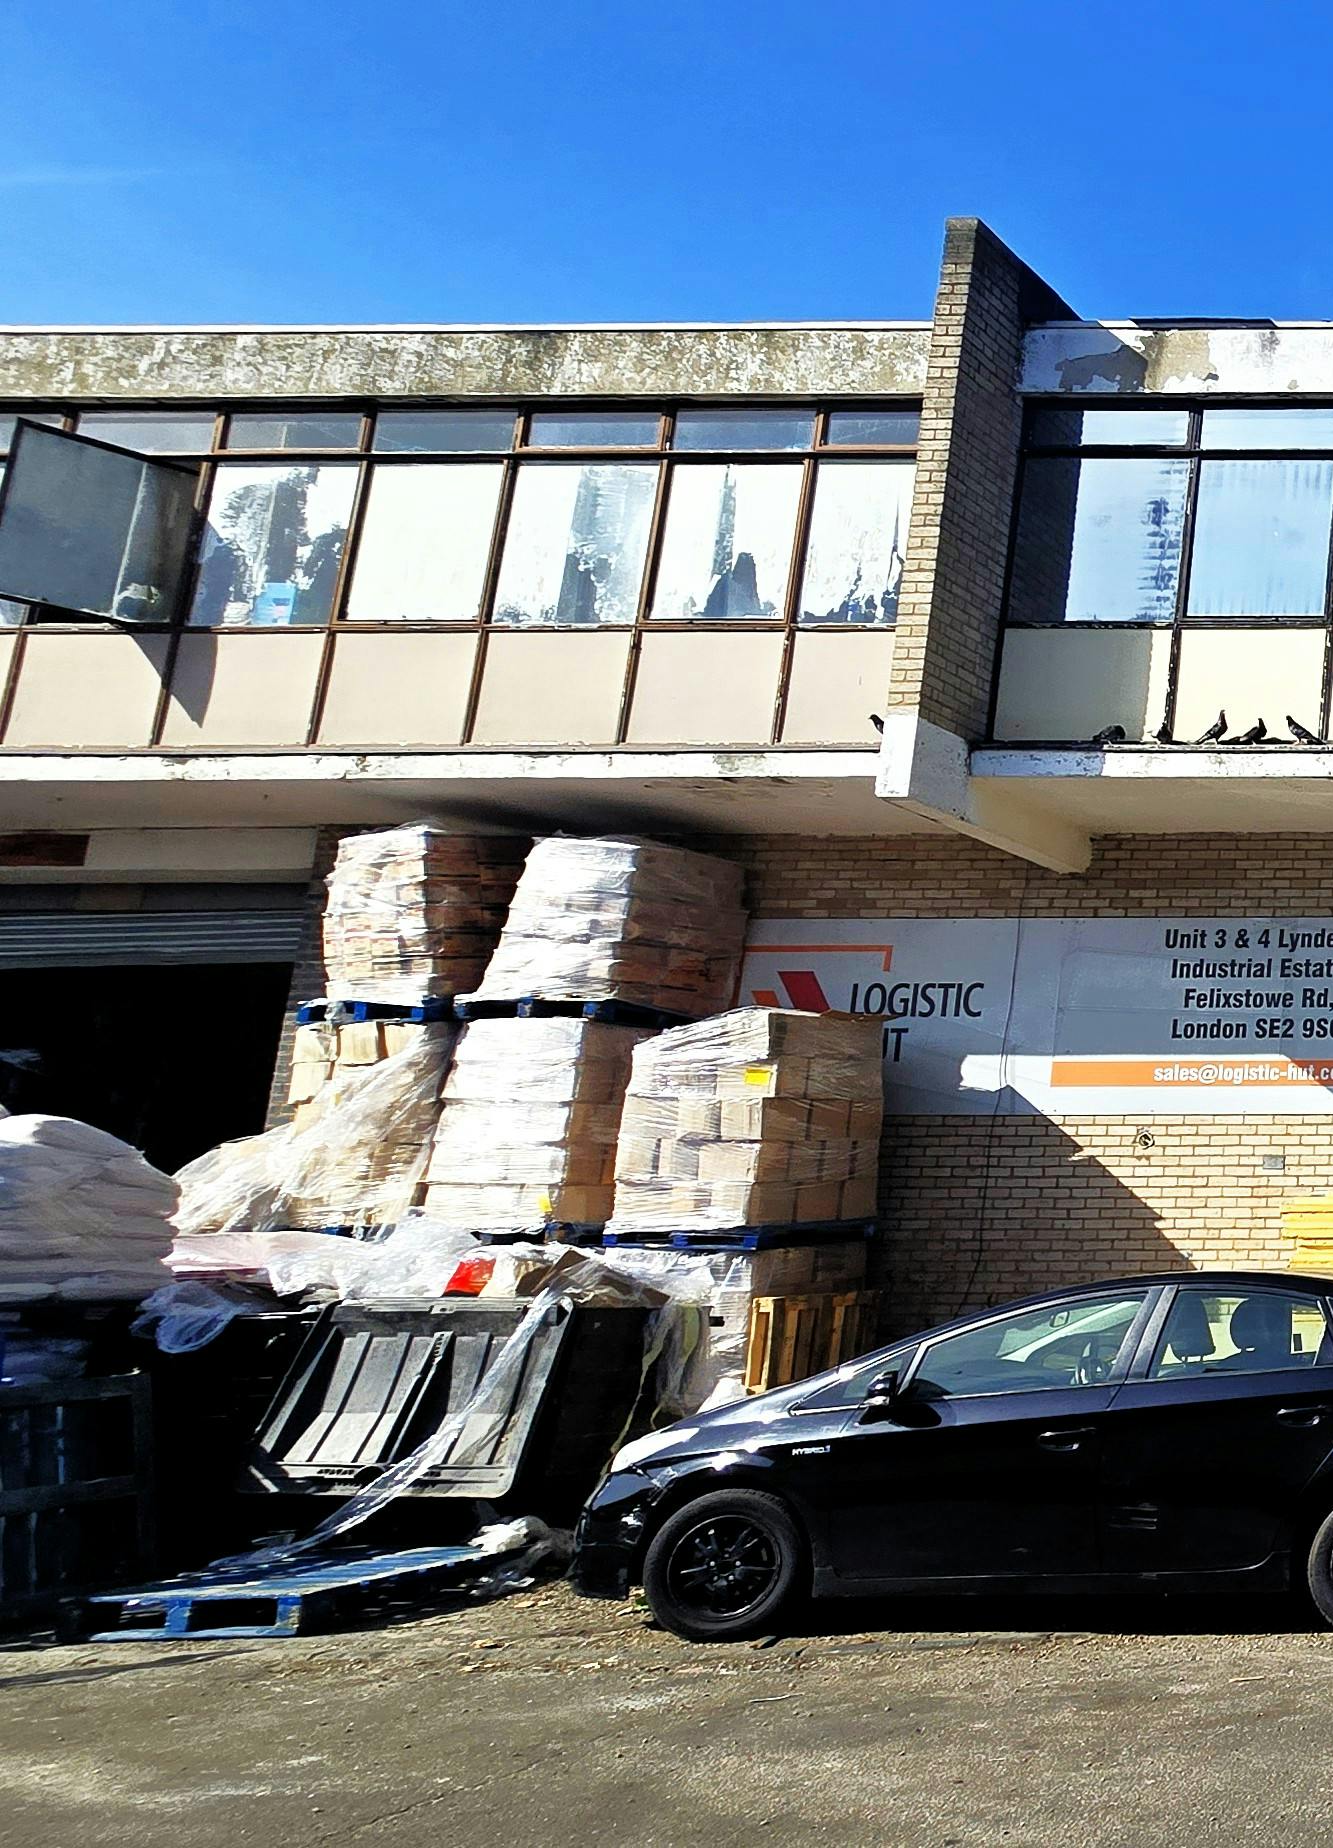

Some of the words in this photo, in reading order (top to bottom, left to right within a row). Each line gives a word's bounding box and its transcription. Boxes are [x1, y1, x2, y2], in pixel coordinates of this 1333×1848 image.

[1165, 928, 1207, 949] Unit
[1214, 928, 1227, 949] 3
[1234, 928, 1250, 949] &
[1257, 928, 1271, 949] 4
[1171, 958, 1272, 979] Industrial
[850, 982, 984, 1017] LOGISTIC
[1183, 987, 1294, 1009] Felixstowe
[1171, 1018, 1247, 1039] London
[1254, 1018, 1295, 1039] SE2
